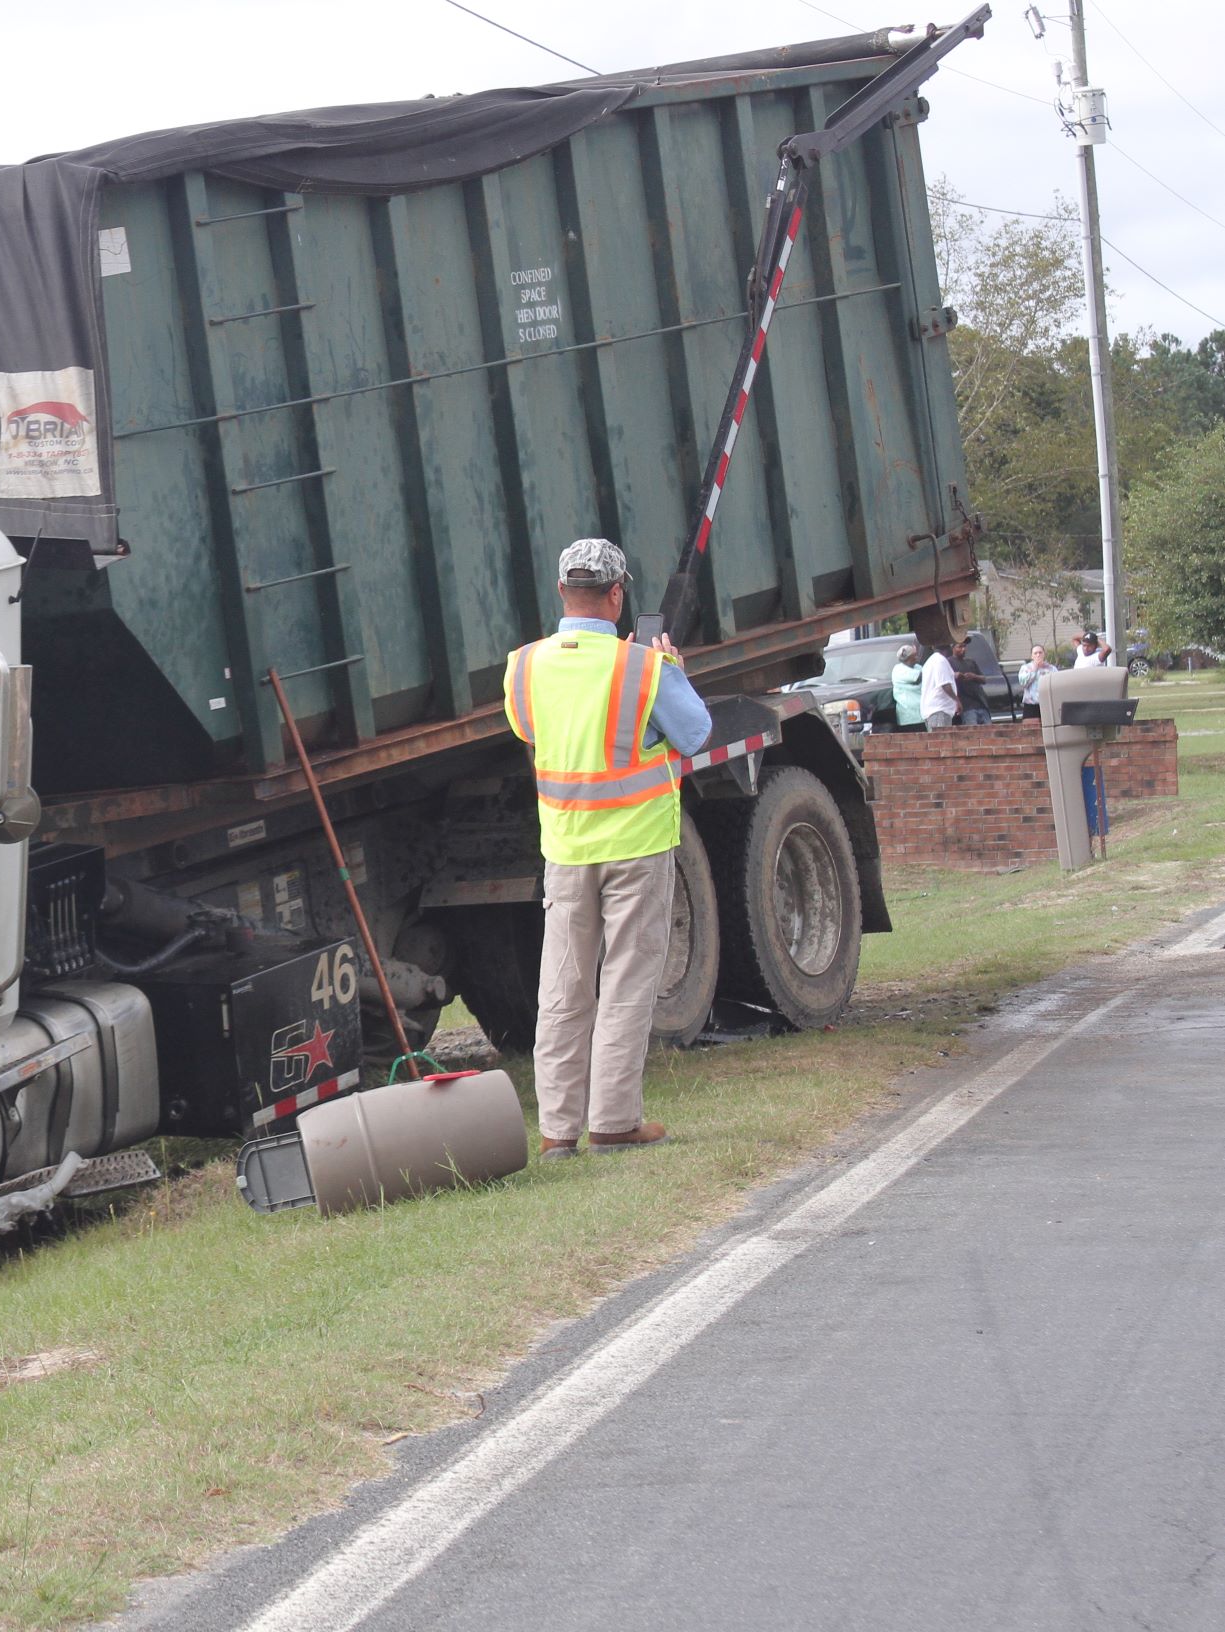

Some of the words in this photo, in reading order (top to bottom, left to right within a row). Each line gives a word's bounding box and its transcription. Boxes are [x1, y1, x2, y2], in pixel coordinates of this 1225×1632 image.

[511, 268, 551, 285] CONFINED
[520, 286, 547, 303] SPACE
[517, 308, 535, 323] HEN
[525, 324, 557, 342] CLOSED
[28, 440, 63, 448] CUSTOM
[310, 943, 357, 1010] 46
